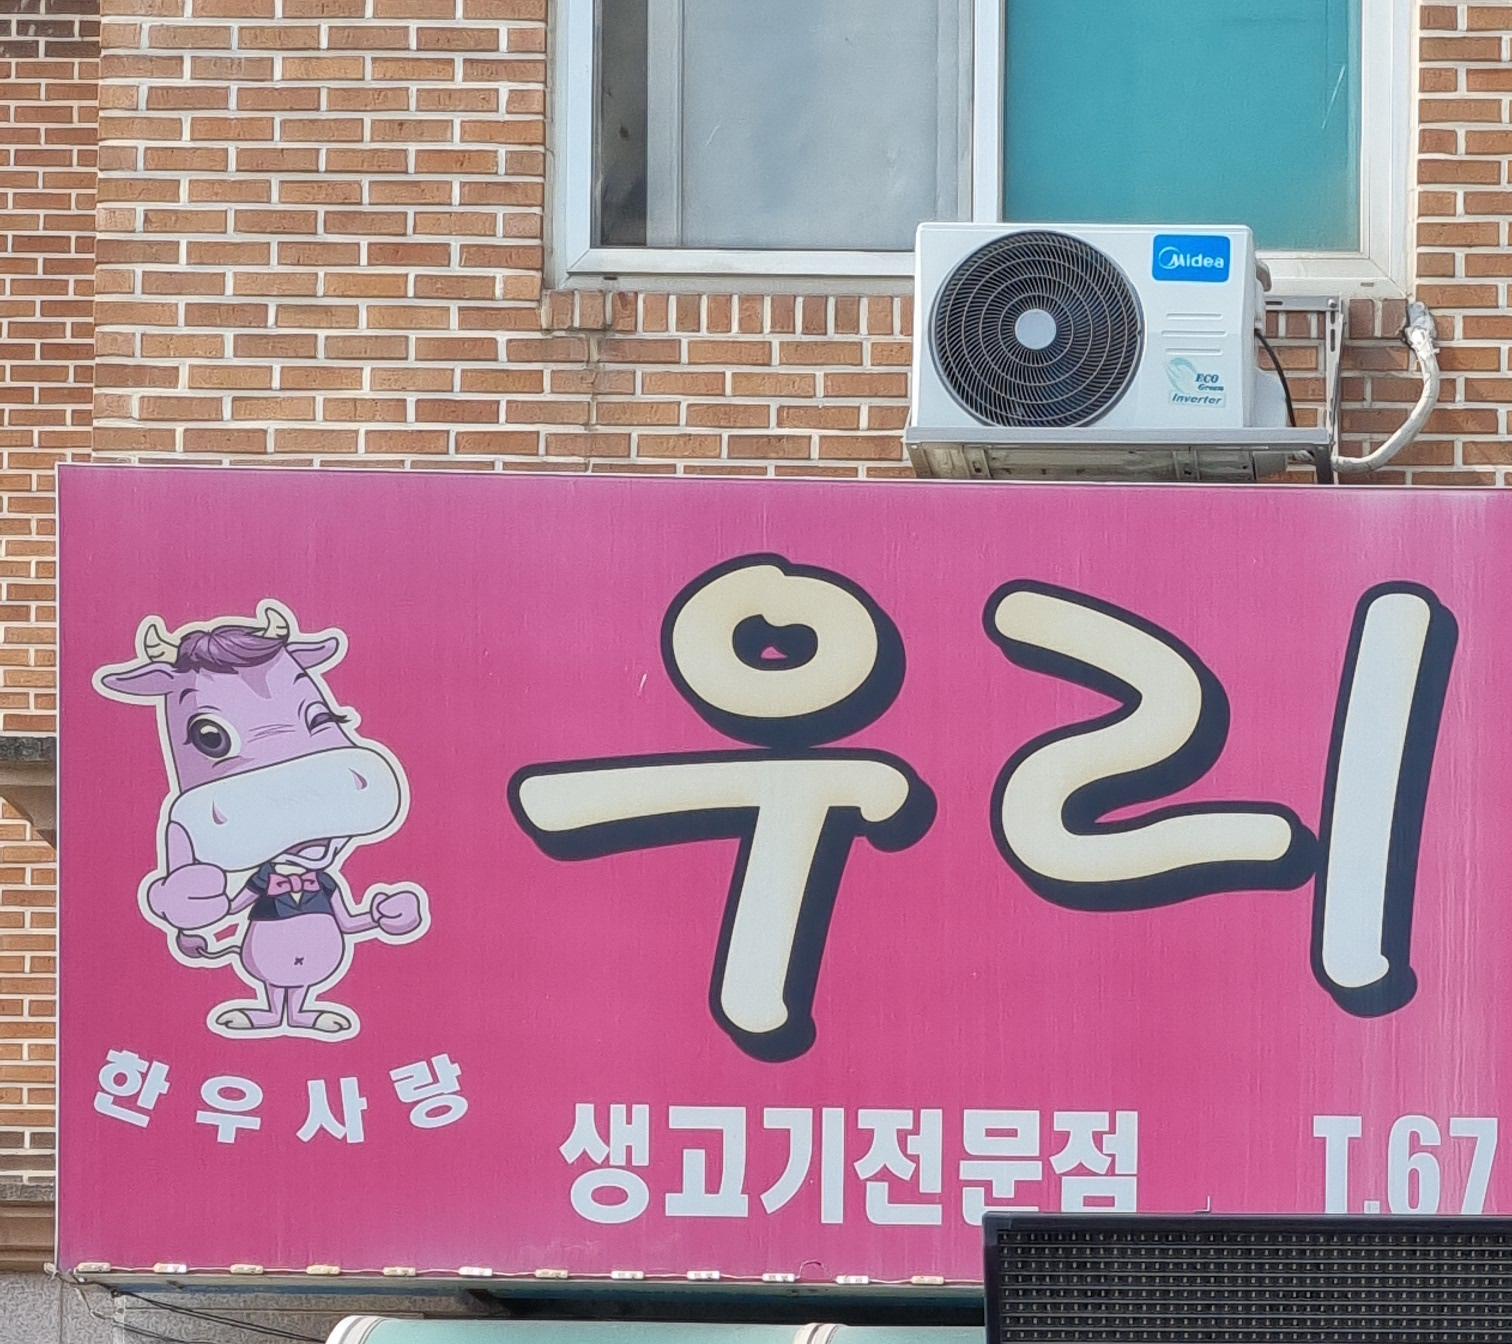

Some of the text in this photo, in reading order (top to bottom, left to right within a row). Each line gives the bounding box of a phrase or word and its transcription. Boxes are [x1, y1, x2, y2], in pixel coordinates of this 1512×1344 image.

[1164, 249, 1225, 270] Midea
[1195, 372, 1220, 384] ECO
[1171, 393, 1223, 406] Inverter
[559, 1102, 1140, 1227] 생고기전문점
